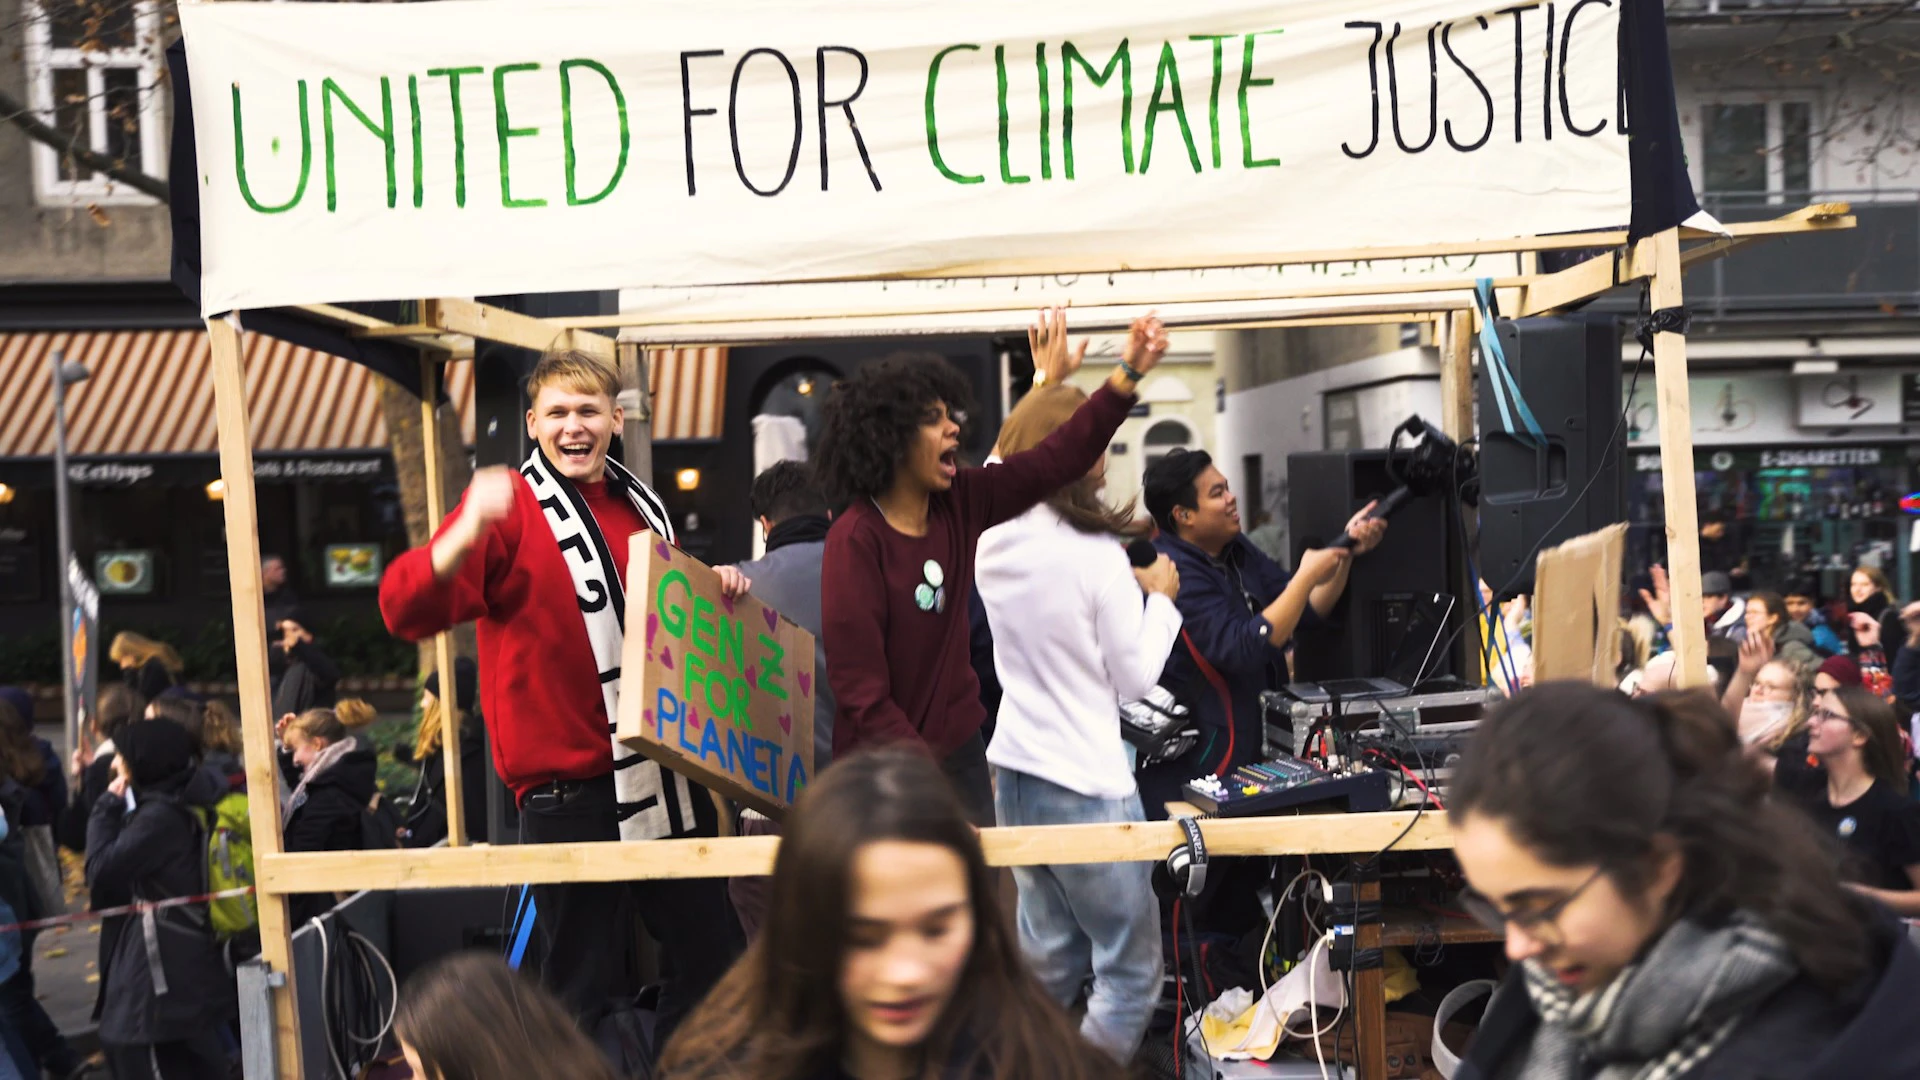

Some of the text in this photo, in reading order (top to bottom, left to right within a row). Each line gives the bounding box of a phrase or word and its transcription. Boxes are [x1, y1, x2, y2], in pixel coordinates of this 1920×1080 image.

[232, 57, 630, 214] UNITED
[680, 46, 883, 197] FOR
[924, 29, 1285, 185] CLIMATE
[656, 569, 789, 700] GEN Z
[683, 651, 753, 731] FOR
[656, 687, 782, 798] PLANET
[785, 752, 807, 804] A
